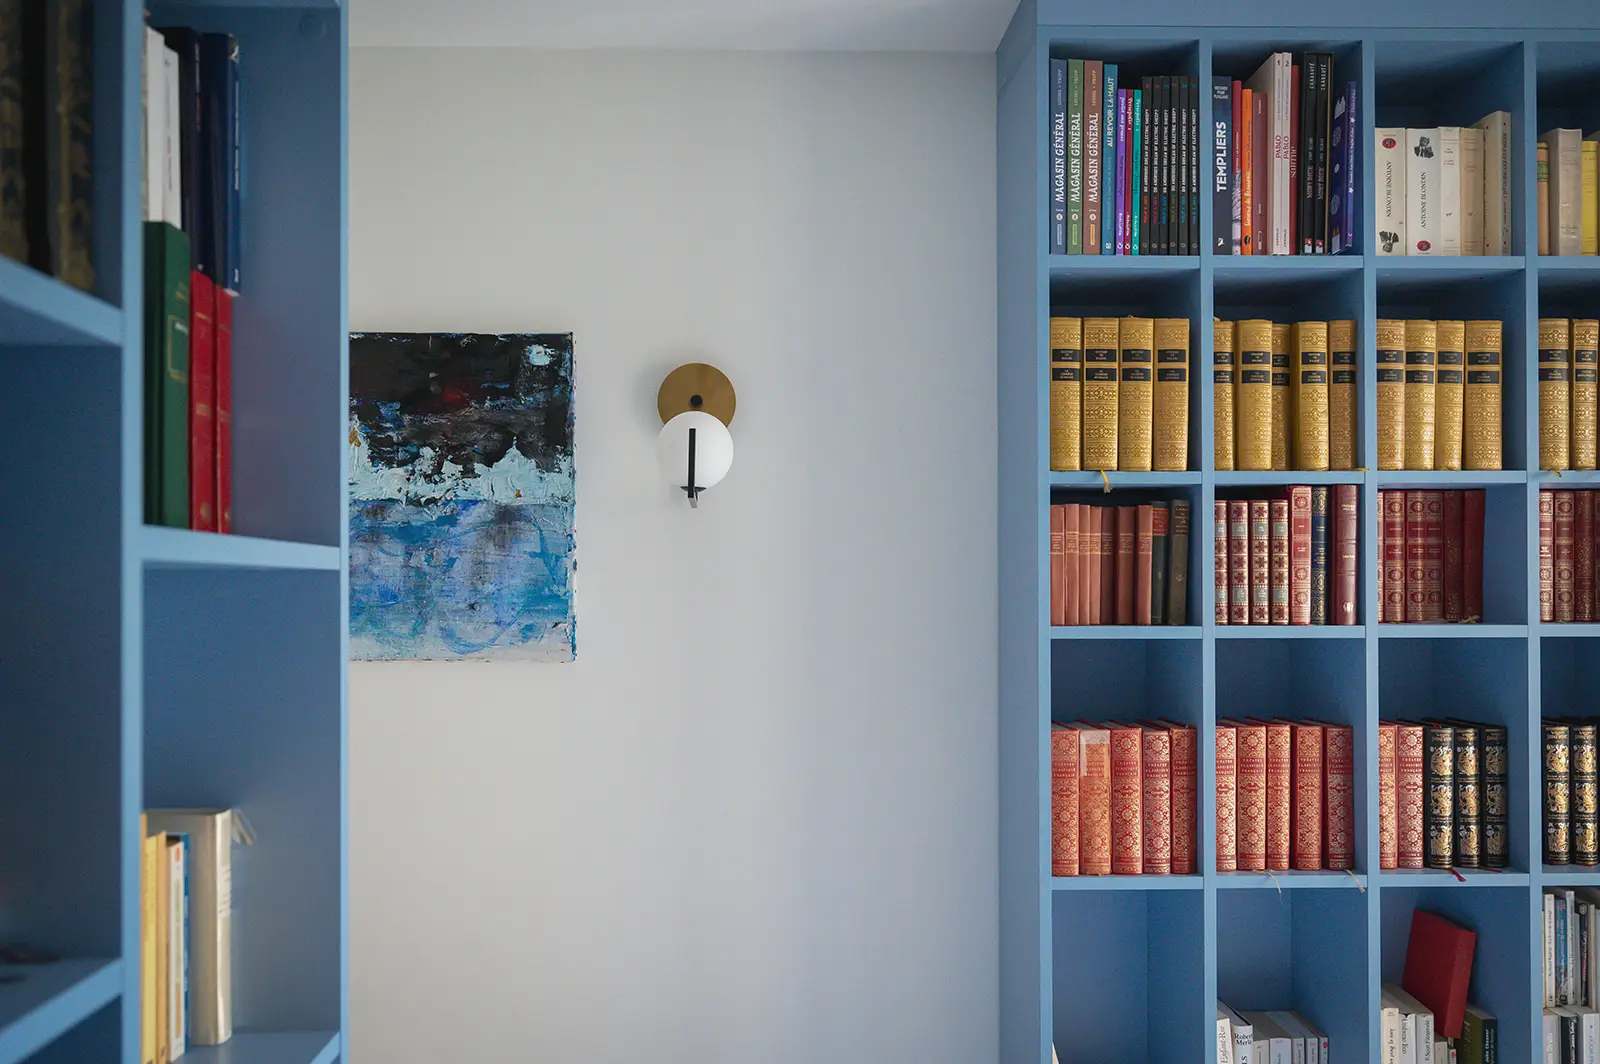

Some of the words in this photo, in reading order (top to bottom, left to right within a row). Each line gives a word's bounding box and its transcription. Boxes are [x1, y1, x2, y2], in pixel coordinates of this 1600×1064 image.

[1053, 112, 1064, 156] GÉNÉRAL
[1069, 112, 1081, 156] GÉNÉRAL
[1087, 112, 1098, 157] GÉNÉRAL
[1107, 136, 1114, 147] AU
[1216, 121, 1227, 192] TEMPLIERS
[1055, 157, 1064, 203] MAGASIN
[1070, 158, 1080, 203] MAGASIN
[1088, 159, 1098, 203] MAGASIN
